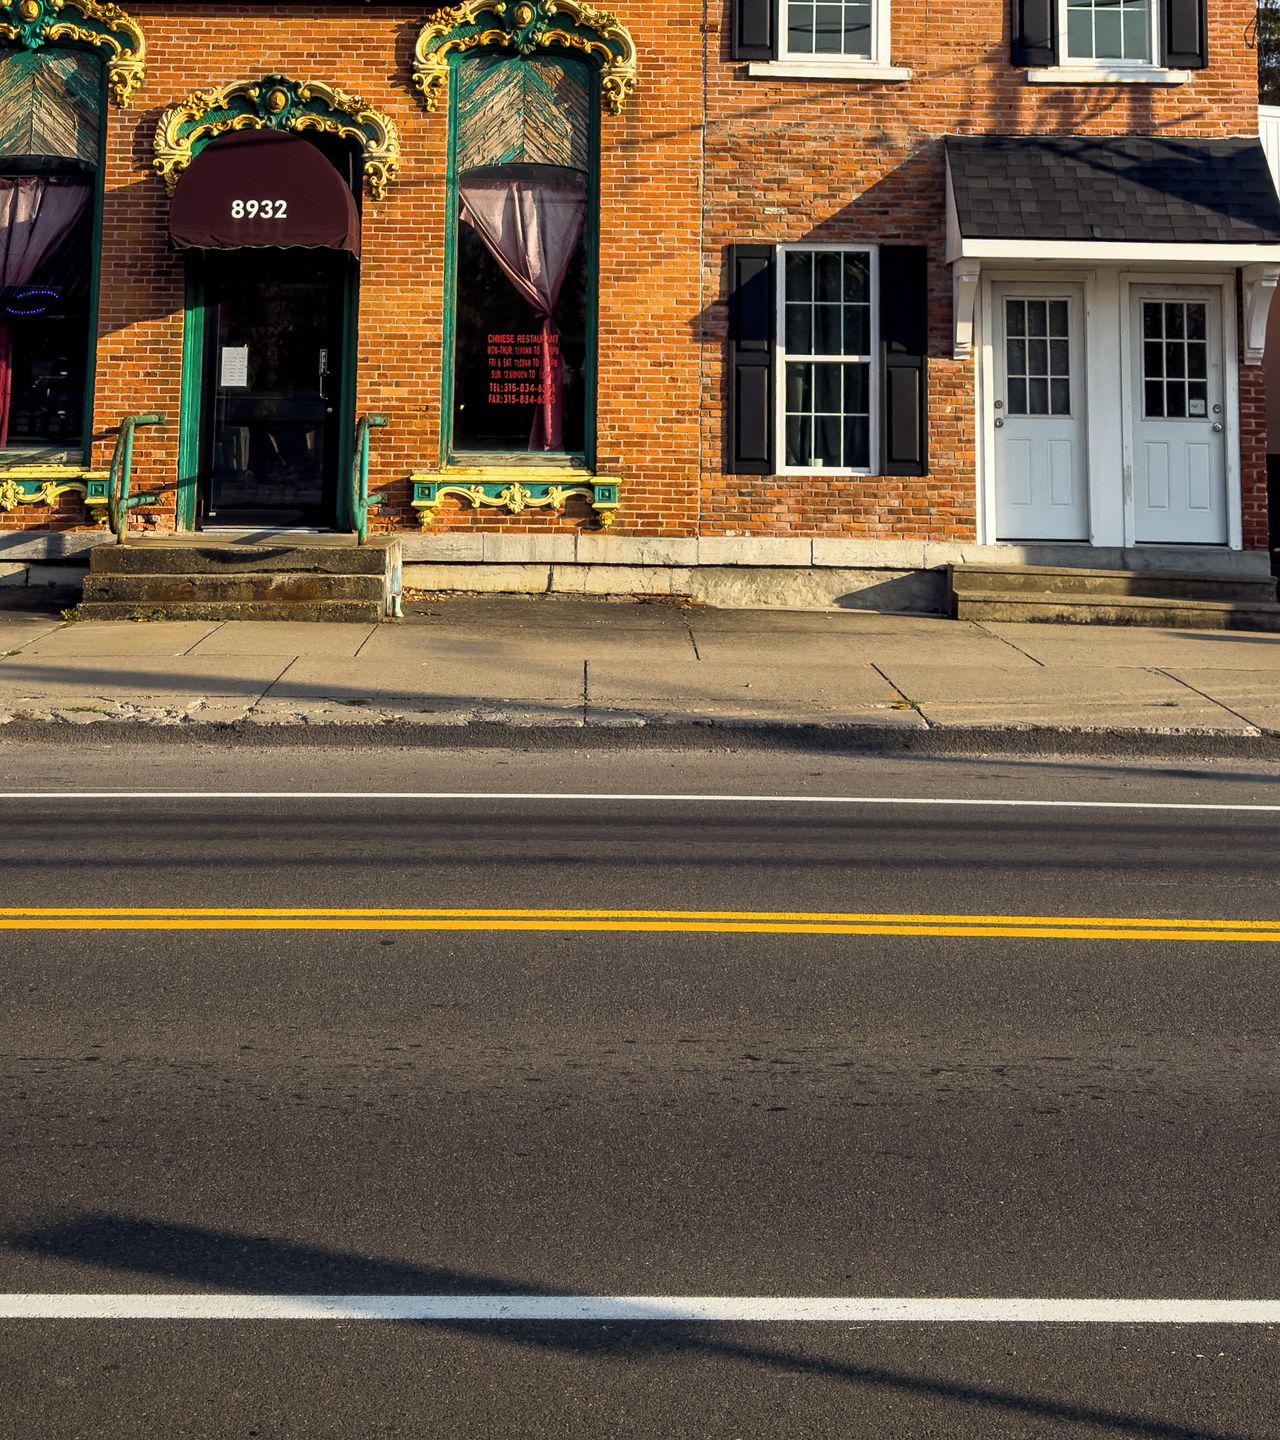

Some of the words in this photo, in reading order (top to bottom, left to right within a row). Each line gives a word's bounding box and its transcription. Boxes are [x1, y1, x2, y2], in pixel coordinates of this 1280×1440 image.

[231, 199, 287, 219] 8932
[488, 335, 515, 344] CHINESE
[517, 335, 559, 344] RESTAURNT
[488, 394, 556, 404] FAX:315-834-65
